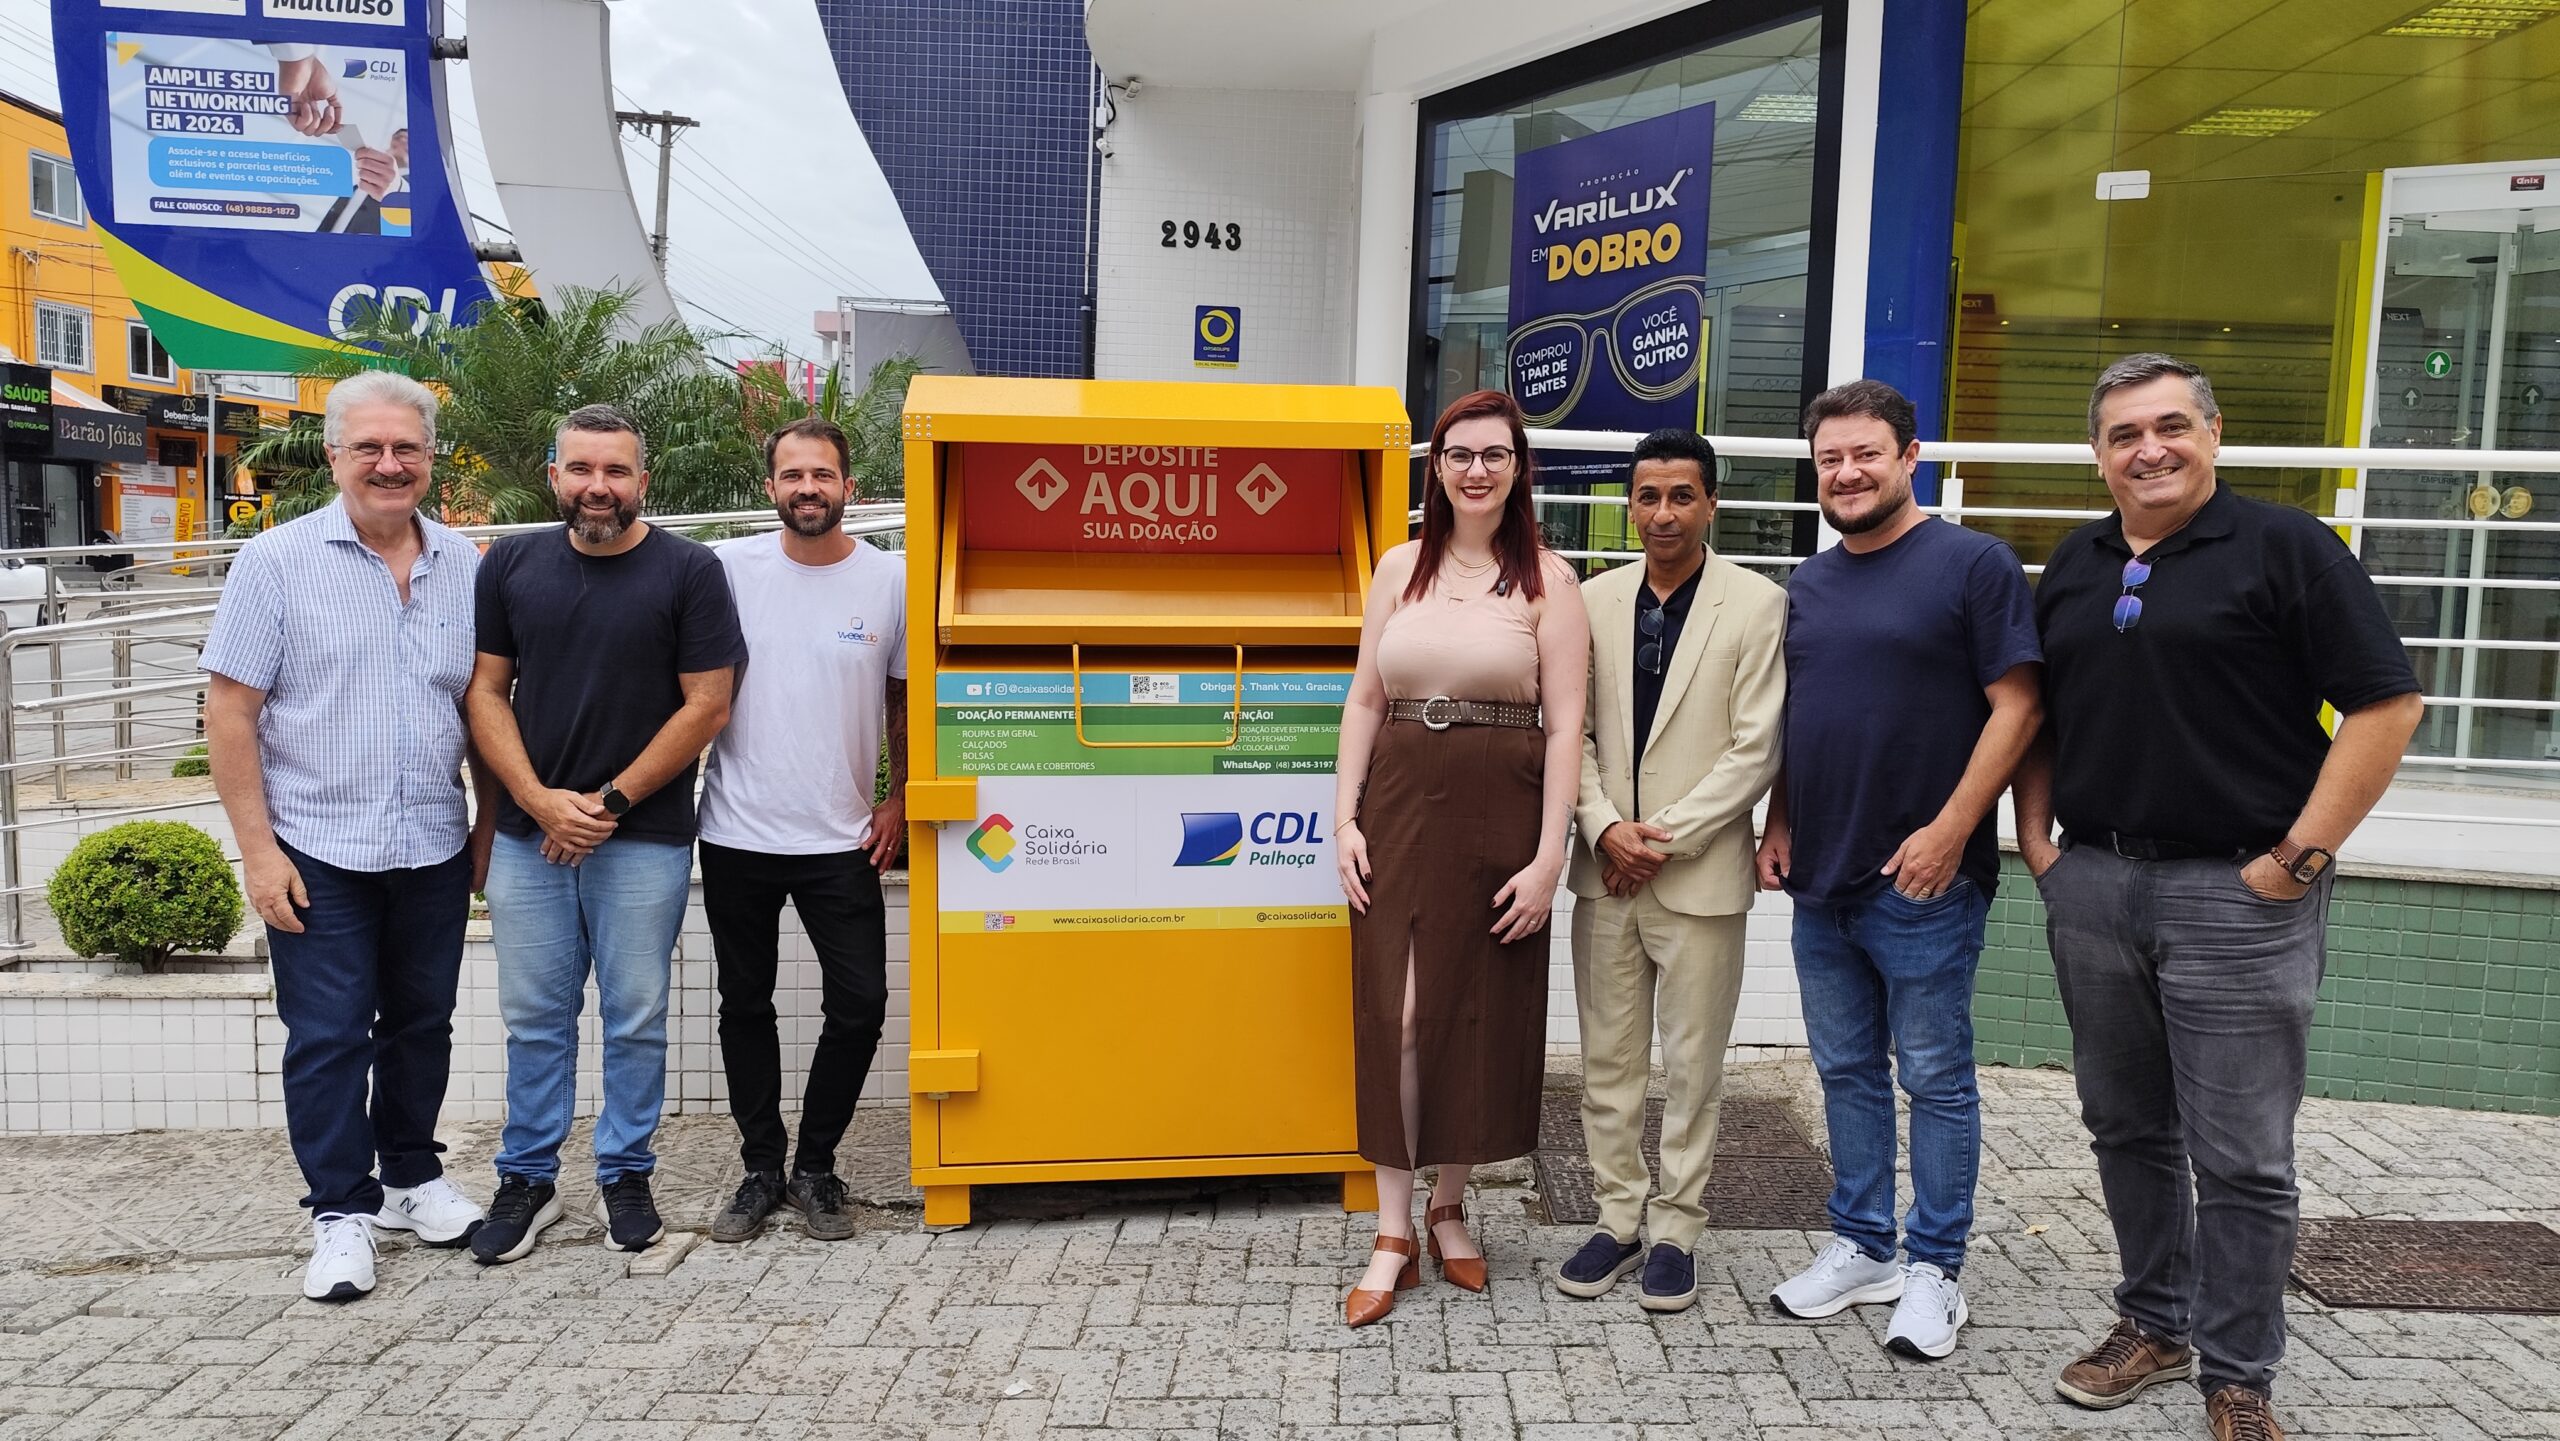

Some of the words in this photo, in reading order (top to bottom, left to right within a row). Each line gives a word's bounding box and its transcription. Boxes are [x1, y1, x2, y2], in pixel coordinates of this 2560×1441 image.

[370, 60, 398, 74] CDL
[148, 67, 225, 88] AMPLIE
[230, 72, 270, 90] SEU
[370, 74, 396, 82] Palhoça
[150, 90, 290, 114] NETWORKING
[151, 113, 180, 130] EM
[186, 115, 240, 134] 2026.
[168, 146, 218, 157] Associe-se
[228, 151, 260, 160] acesse
[168, 158, 216, 168] exclusivos
[226, 161, 270, 172] parcerias
[272, 163, 334, 176] estratégicas,
[169, 170, 192, 180] além
[194, 171, 206, 180] de
[208, 172, 246, 182] eventos
[256, 174, 320, 186] capacitações.
[1580, 168, 1639, 188] PROMOÇÃO
[154, 201, 176, 210] FALE
[176, 202, 222, 212] CONOSCO:
[226, 202, 244, 214] (48)
[246, 204, 296, 216] 98828-1872
[1161, 220, 1242, 250] 2943
[1532, 246, 1548, 262] EM
[1548, 222, 1682, 282] DOBRO
[1642, 306, 1678, 330] VOCÊ
[2386, 312, 2412, 321] NEXT
[1632, 322, 1688, 351] GANHA
[1516, 341, 1572, 368] COMPROU
[1634, 342, 1688, 370] OUTRO
[1520, 369, 1526, 382] 1
[1528, 364, 1551, 380] PAR
[1552, 359, 1568, 374] DE
[4, 382, 49, 404] SAÚDE
[1525, 376, 1567, 398] LENTES
[60, 418, 104, 442] Barão
[108, 424, 142, 450] Jóias
[1083, 444, 1219, 468] DEPOSITE
[1079, 472, 1218, 522] AQUI
[175, 502, 191, 571] ETANAMENTO
[1083, 522, 1124, 540] SUA
[1130, 520, 1218, 544] DOAÇÃO
[1009, 684, 1084, 694] @caixasolidara
[1250, 682, 1280, 691] Thank
[1282, 682, 1303, 691] You.
[1306, 682, 1344, 691] Gracias.
[956, 709, 1002, 722] DOAÇÃO
[962, 730, 995, 738] ROUPAS
[998, 730, 1009, 738] EM
[1011, 730, 1038, 738] GERAL
[1241, 726, 1269, 734] DOAÇÃO
[962, 741, 1008, 750] CALÇADOS
[963, 752, 994, 760] BOLSAS
[963, 763, 996, 771] ROUPAS
[1043, 762, 1095, 770] COBERTORES
[1223, 761, 1271, 770] WhatsApp
[1276, 761, 1290, 769] (48)
[1291, 761, 1334, 769] 3045-3197
[1025, 824, 1074, 839] Caixa
[1249, 811, 1324, 844] CDL
[1025, 840, 1108, 855] Solidária
[1025, 857, 1050, 865] Rede
[1052, 856, 1080, 865] Brasil
[1249, 851, 1316, 868] Palhoça
[1052, 914, 1186, 925] www.caixasolidaria.com.br
[1256, 911, 1337, 922] @caixasolidaria
[400, 1196, 417, 1214] N
